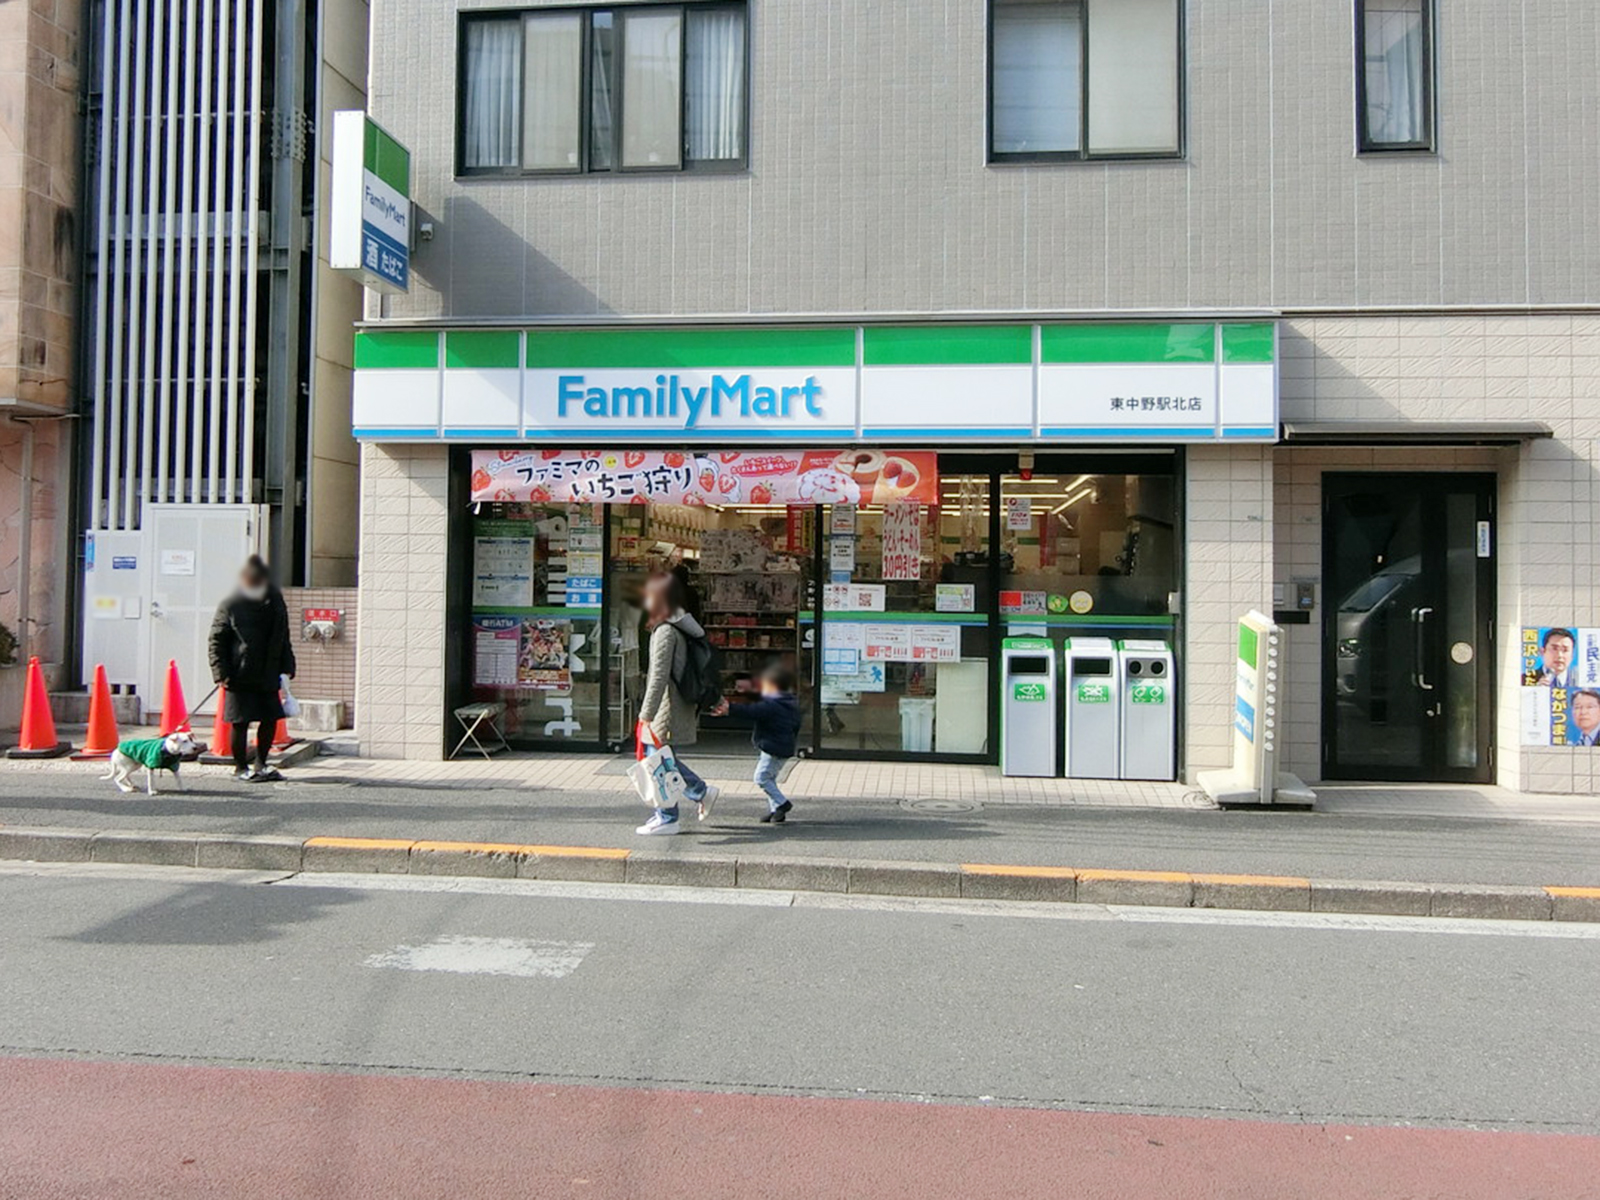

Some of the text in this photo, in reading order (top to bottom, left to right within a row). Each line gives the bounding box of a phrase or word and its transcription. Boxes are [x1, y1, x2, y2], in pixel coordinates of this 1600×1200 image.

[365, 185, 406, 227] FamilyMart
[366, 238, 403, 281] 酒 たばこ
[557, 374, 822, 429] FamilyMart
[1109, 396, 1203, 411] 東中野駅北店
[517, 458, 600, 485] ファミマの
[571, 465, 692, 499] いちご狩り
[571, 578, 597, 588] たばこ
[883, 554, 919, 578] 30円引き
[1521, 628, 1539, 686] 西沢けいた
